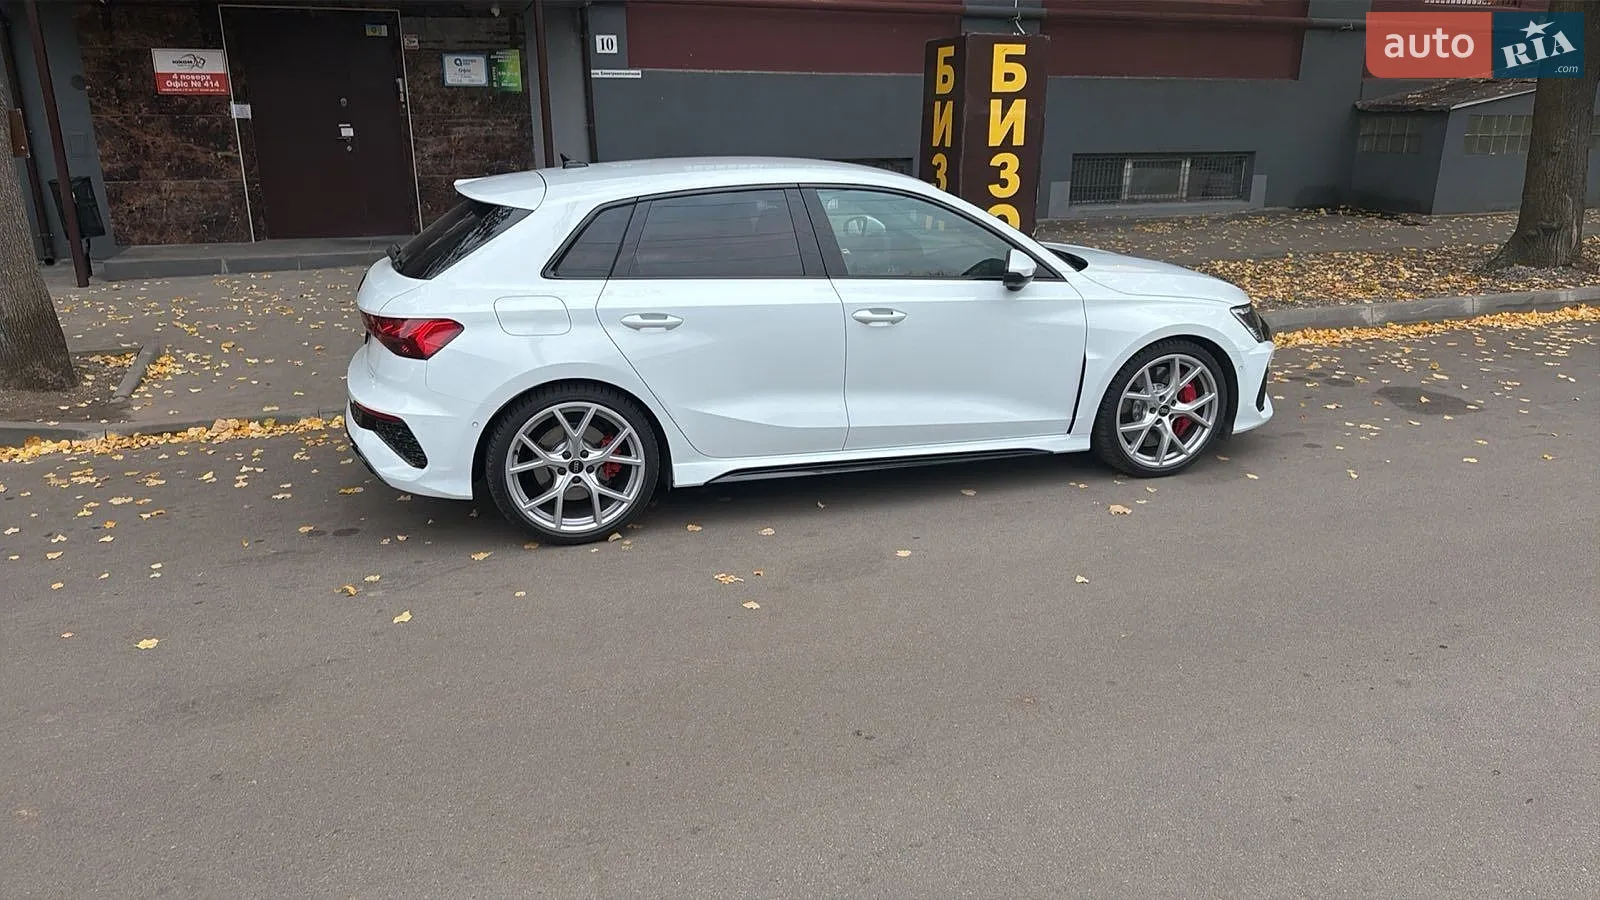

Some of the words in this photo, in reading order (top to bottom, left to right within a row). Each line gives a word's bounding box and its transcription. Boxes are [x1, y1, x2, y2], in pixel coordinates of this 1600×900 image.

[600, 37, 614, 51] 10
[166, 80, 188, 88] Офіс
[191, 80, 202, 88] №
[204, 80, 220, 88] 414
